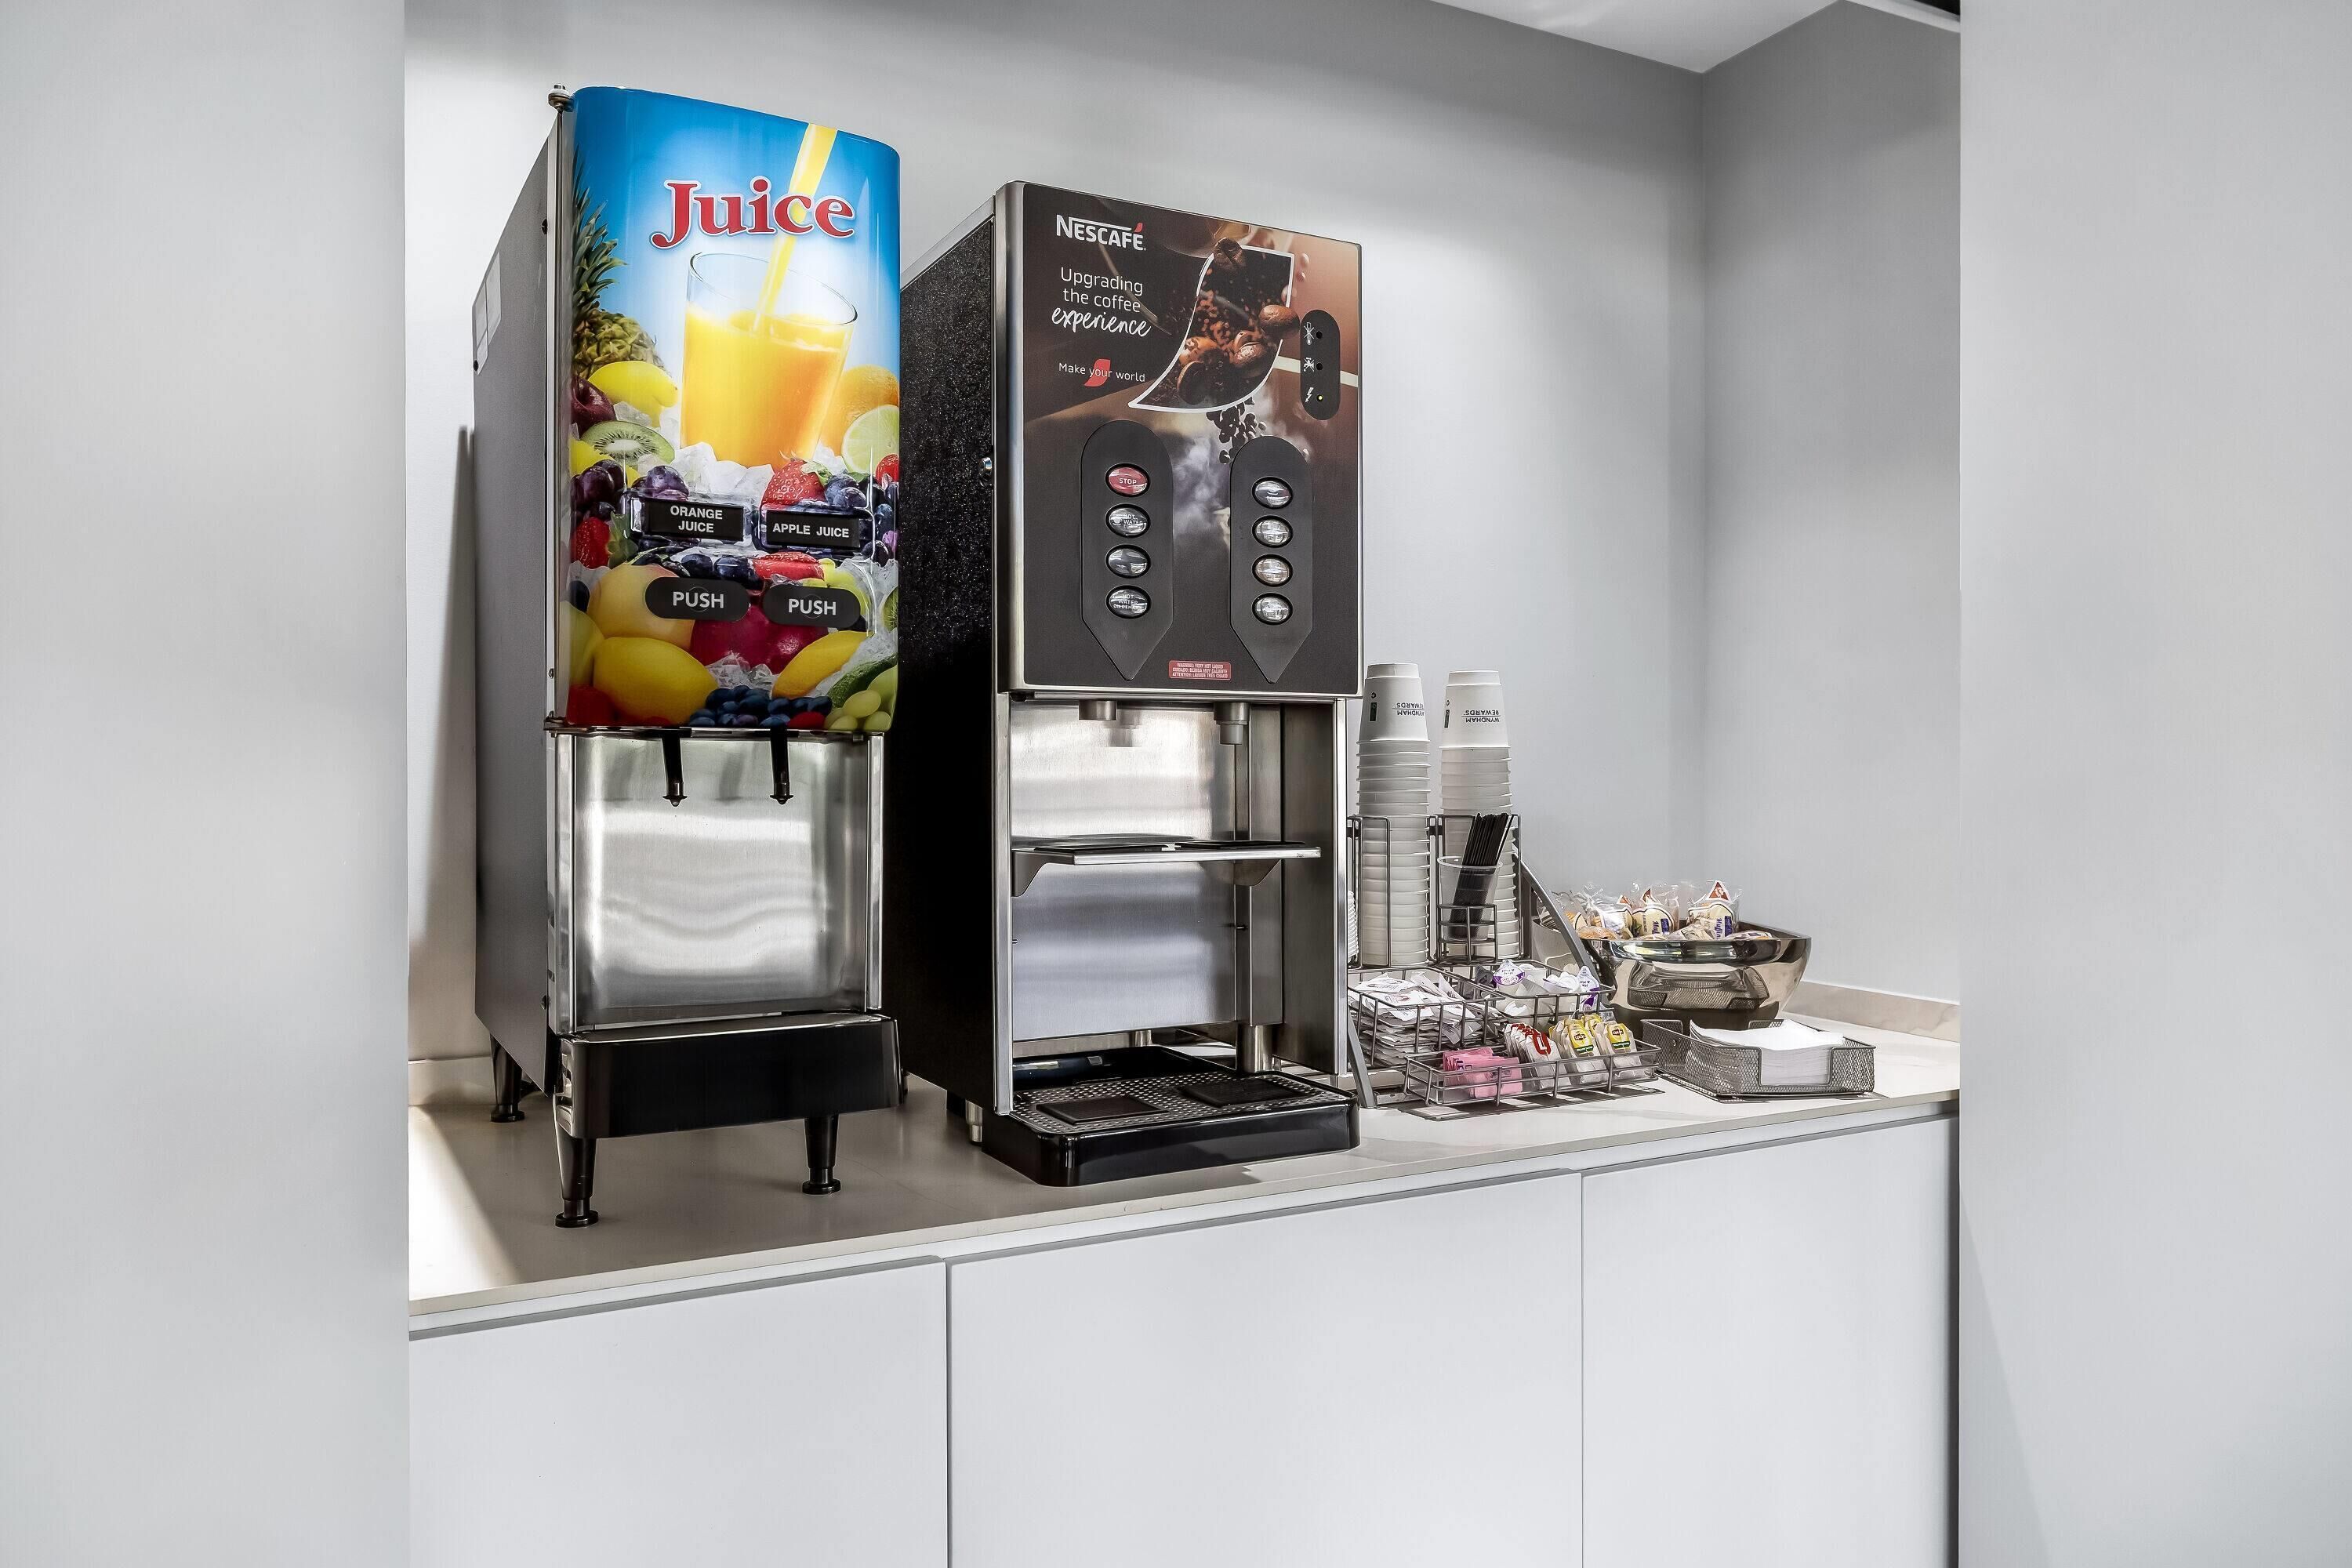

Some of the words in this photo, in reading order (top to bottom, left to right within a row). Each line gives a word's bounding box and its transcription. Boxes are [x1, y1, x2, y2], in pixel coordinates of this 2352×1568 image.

[650, 176, 856, 249] Juice
[1056, 214, 1145, 251] NESCAFÉ
[1061, 267, 1143, 296] Upgrading
[1063, 288, 1091, 306] the
[1094, 293, 1141, 313] coffee
[1051, 307, 1151, 337] experience
[1058, 362, 1086, 376] Make
[1089, 365, 1112, 379] your
[1116, 370, 1145, 383] world
[670, 505, 723, 520] ORANGE
[678, 521, 714, 533] JUICE
[772, 522, 811, 535] APPLE
[816, 526, 849, 538] JUICE
[673, 591, 724, 608] PUSH
[788, 598, 837, 615] PUSH
